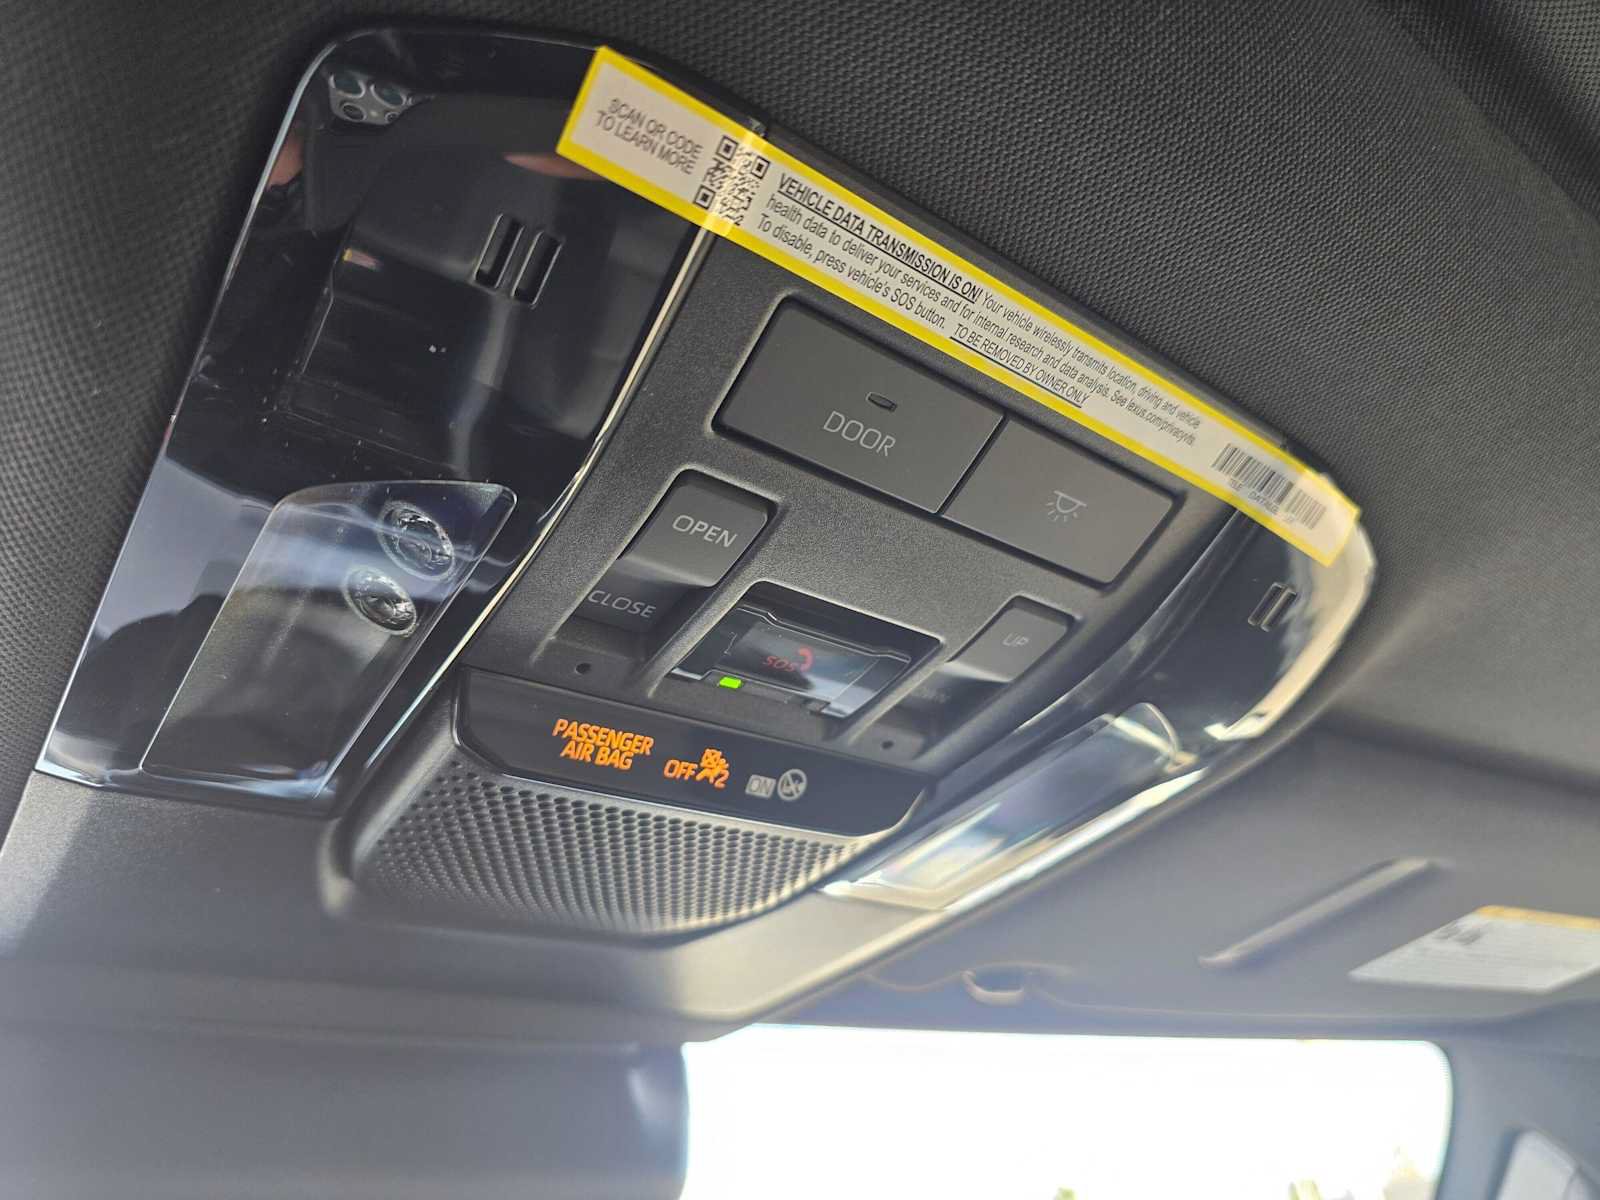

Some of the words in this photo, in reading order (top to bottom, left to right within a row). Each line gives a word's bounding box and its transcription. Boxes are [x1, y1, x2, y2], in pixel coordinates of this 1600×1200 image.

[596, 111, 615, 132] TO
[614, 122, 660, 155] LEARN
[658, 145, 696, 175] MORE
[608, 98, 648, 128] SCAN
[666, 131, 704, 160] CODE
[757, 213, 772, 233] To
[771, 221, 814, 258] disable,
[813, 247, 847, 274] press
[847, 262, 893, 298] vehicle's
[890, 288, 916, 311] SOS
[914, 301, 946, 329] button.
[954, 323, 969, 339] TO
[967, 331, 983, 347] BE
[980, 338, 1025, 370] REMOVED
[1022, 361, 1039, 376] BY
[1035, 369, 1067, 393] OWNER
[1065, 386, 1090, 404] ONLY
[765, 193, 802, 225] health
[803, 214, 829, 238] data
[828, 229, 842, 246] to
[842, 238, 879, 266] deliver
[875, 259, 902, 280] your
[900, 271, 942, 302] services
[942, 296, 961, 313] and
[960, 304, 975, 321] for
[973, 311, 1009, 339] internal
[1006, 333, 1044, 360] research
[1042, 354, 1061, 369] and
[1060, 358, 1077, 379] data
[1077, 373, 1110, 398] analysis.
[1110, 390, 1126, 407] See
[779, 173, 832, 216] VEHICLE
[831, 202, 866, 236] DATA
[867, 225, 952, 283] TRANSMISSION
[950, 275, 963, 290] IS
[962, 281, 984, 302] ON!
[982, 292, 1003, 314] Your
[1002, 307, 1034, 332] vehicle
[1032, 324, 1073, 357] wirelessly
[1072, 346, 1108, 375] transmits
[1137, 386, 1161, 410] driving
[1161, 401, 1177, 415] and
[1176, 409, 1201, 429] vehicle
[823, 410, 896, 457] DOOR
[672, 514, 738, 548] OPEN
[587, 589, 656, 618] CLOSE
[1003, 633, 1029, 647] UP
[763, 655, 798, 672] SOS
[552, 718, 654, 756] PASSENGER
[560, 740, 594, 762] AIR
[595, 747, 634, 771] BAG
[663, 759, 698, 780] OFF
